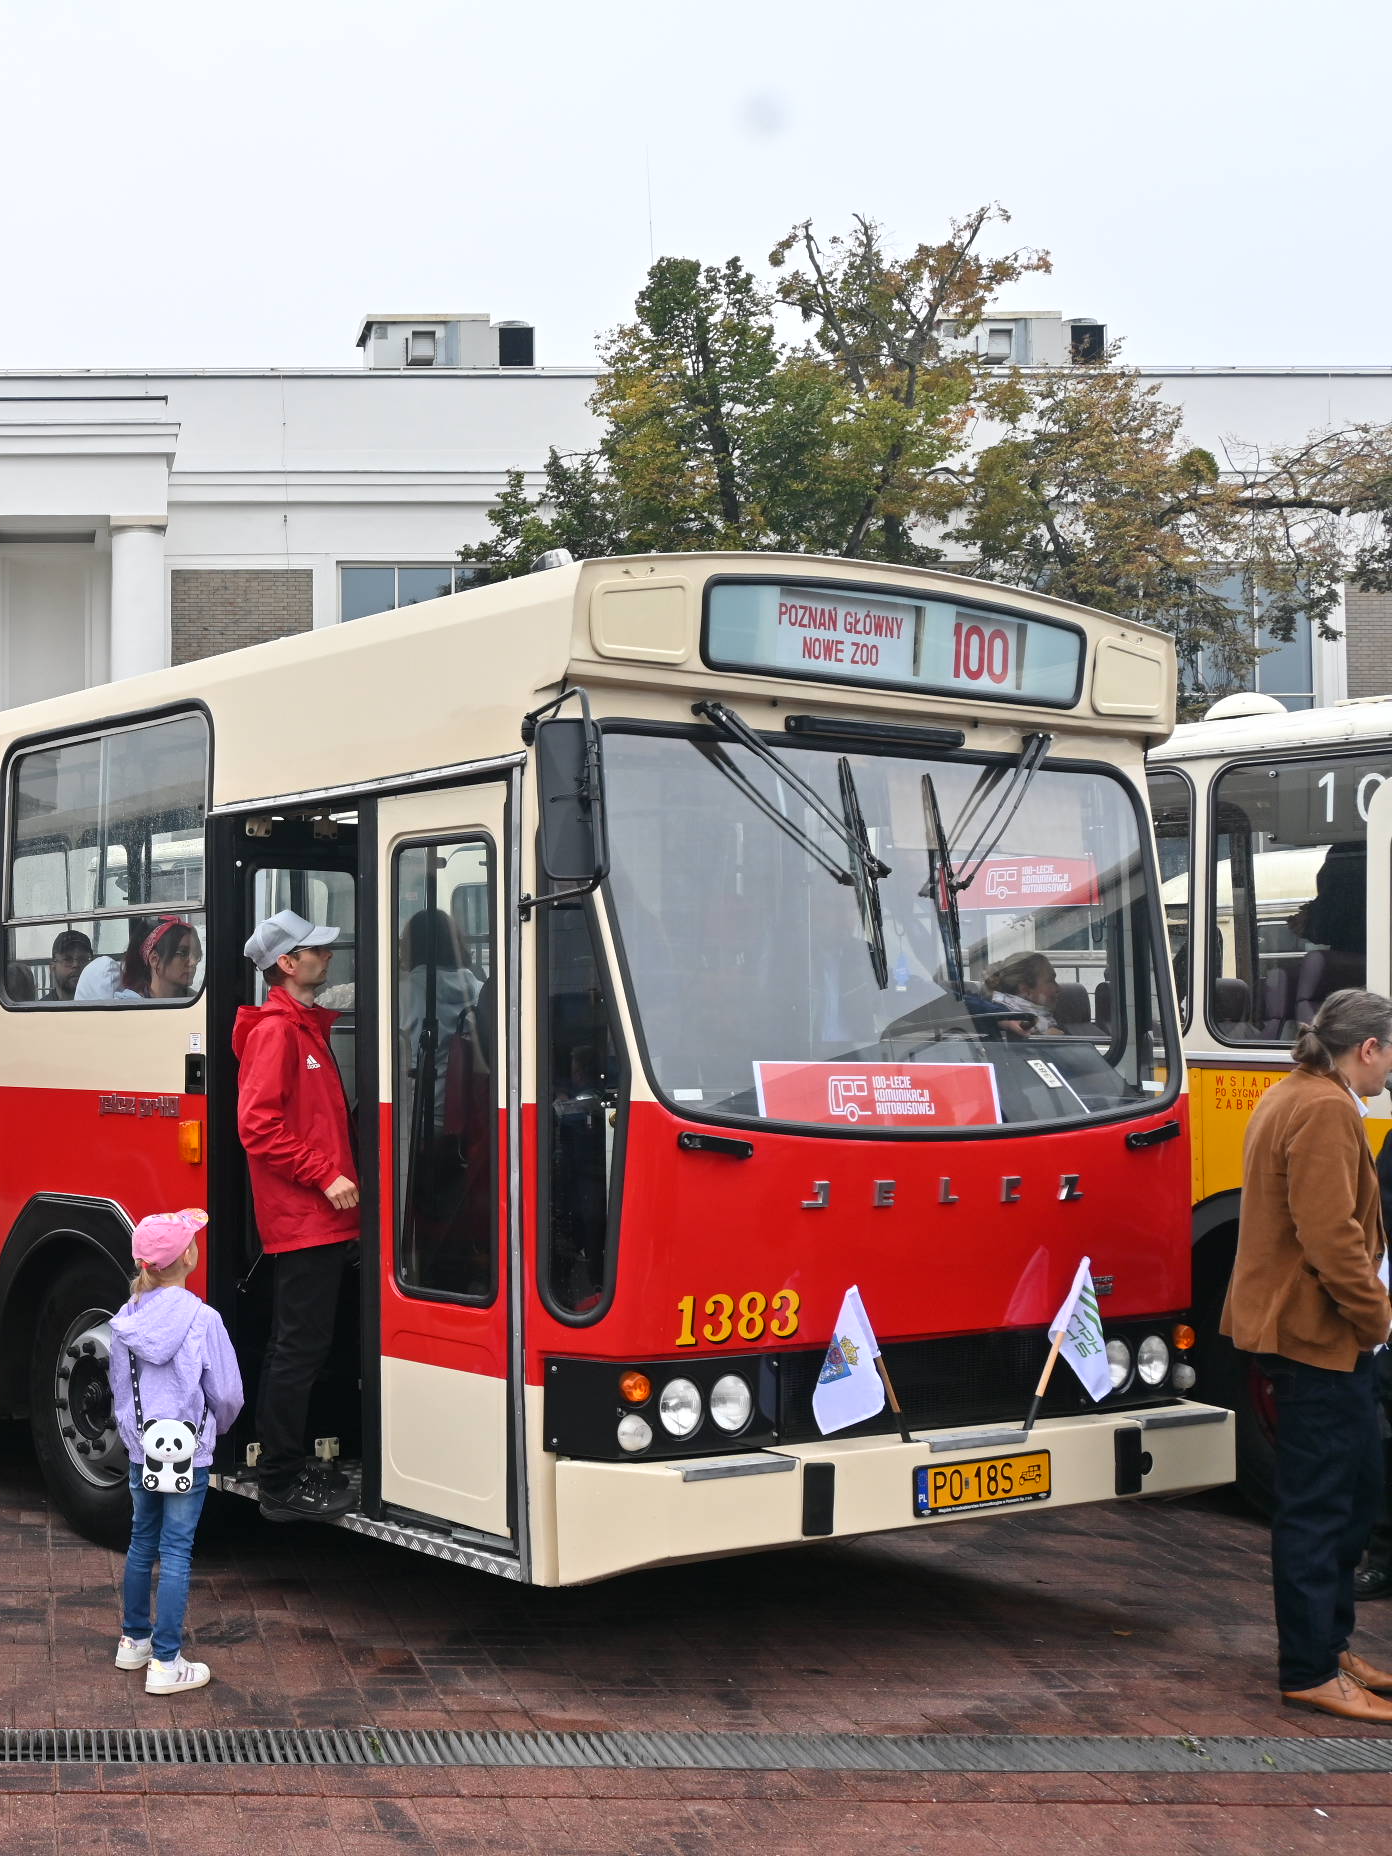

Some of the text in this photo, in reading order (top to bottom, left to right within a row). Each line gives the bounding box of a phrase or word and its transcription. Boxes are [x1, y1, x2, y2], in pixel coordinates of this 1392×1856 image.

[778, 602, 904, 641] POZNAŃ GŁÓWNY
[802, 636, 879, 667] NOWE ZOO
[953, 621, 1009, 685] 100
[872, 1076, 912, 1089] 100-LECIE
[873, 1088, 930, 1102] KOMUNIKACJI
[1215, 1087, 1227, 1097] PO
[876, 1102, 936, 1115] AUTOBUSOWEJ
[801, 1174, 1085, 1208] JELCZ
[675, 1289, 801, 1347] 1383
[918, 1494, 927, 1503] PL
[933, 1469, 963, 1504] PO
[974, 1462, 1013, 1499] 18S
